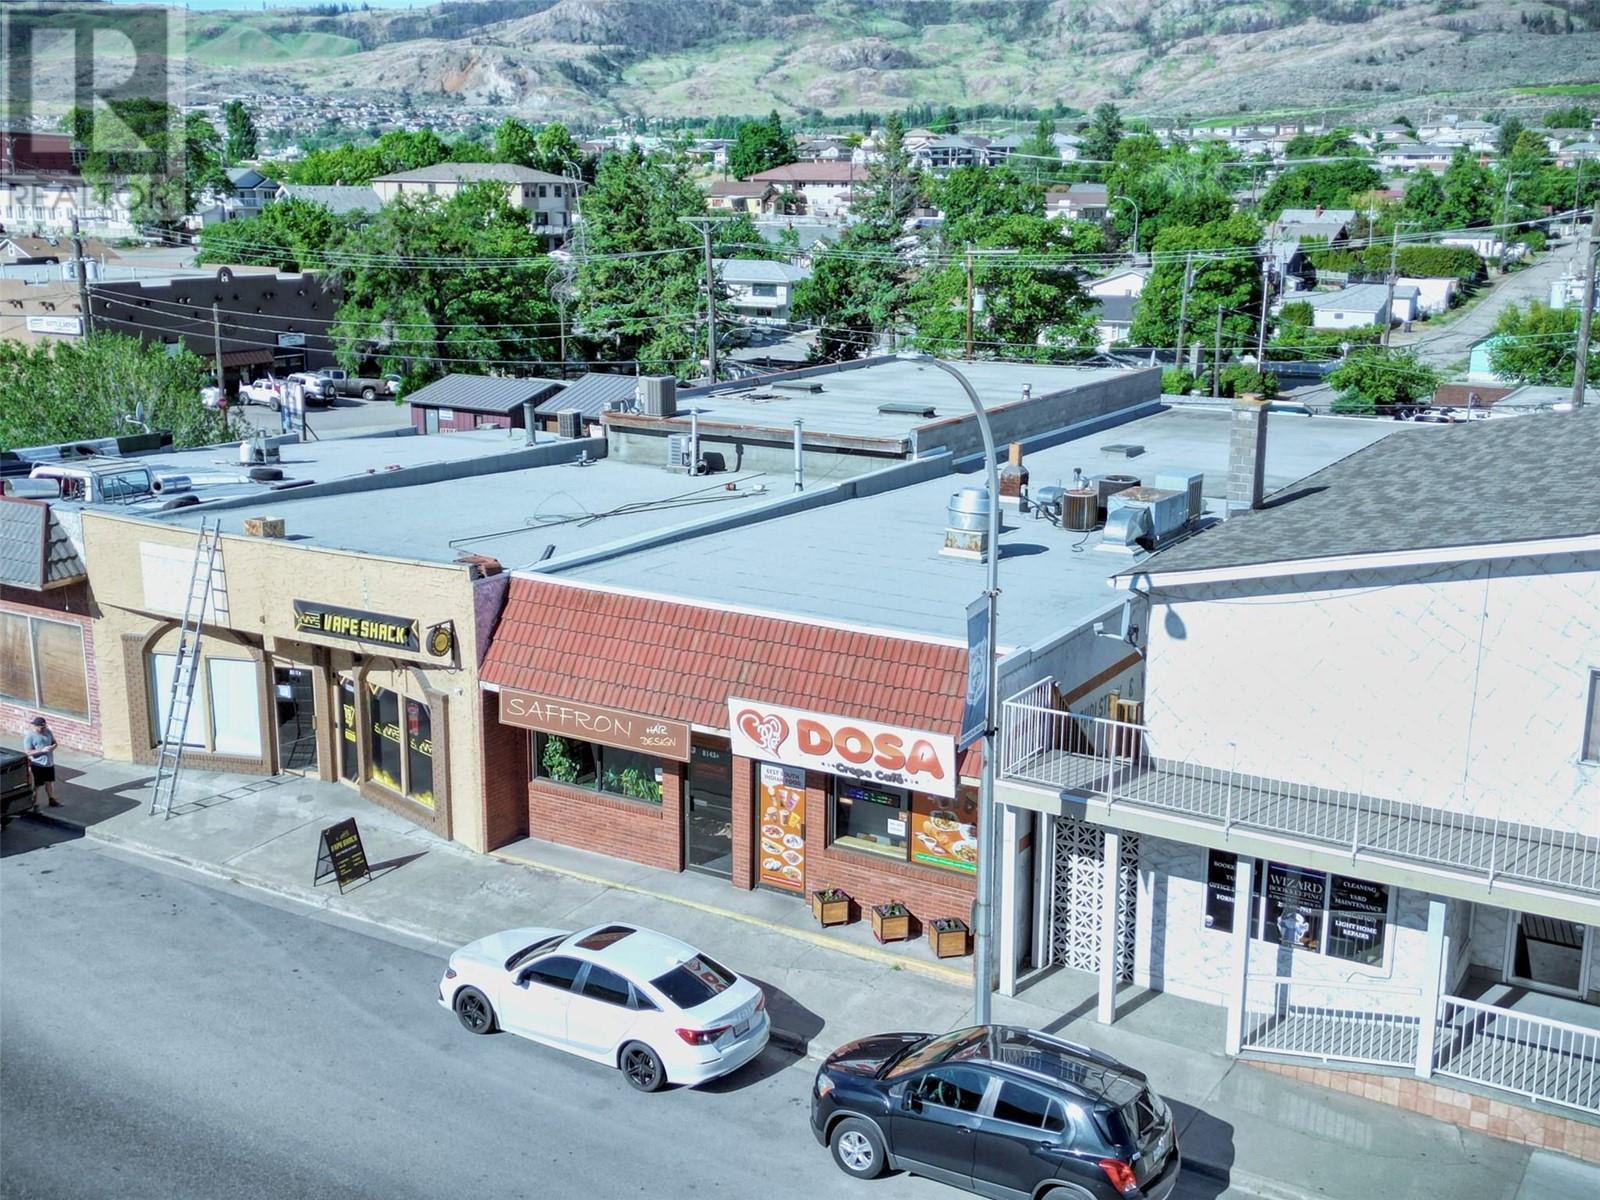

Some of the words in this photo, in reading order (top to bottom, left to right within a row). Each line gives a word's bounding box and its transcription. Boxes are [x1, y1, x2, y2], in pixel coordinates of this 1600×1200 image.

[323, 614, 359, 636] VAPE
[359, 620, 405, 644] SHACK
[506, 698, 632, 738] SAFFRON
[639, 736, 677, 747] DESIGN
[796, 718, 945, 780] DOSA
[835, 762, 872, 778] Crepe
[1270, 873, 1324, 894] WIZARD
[1342, 881, 1377, 894] CLEANING
[1334, 898, 1383, 912] MAINTENANCE
[1335, 919, 1356, 930] LIGHT
[1355, 924, 1378, 935] HOME
[1342, 928, 1370, 940] REPAIRS
